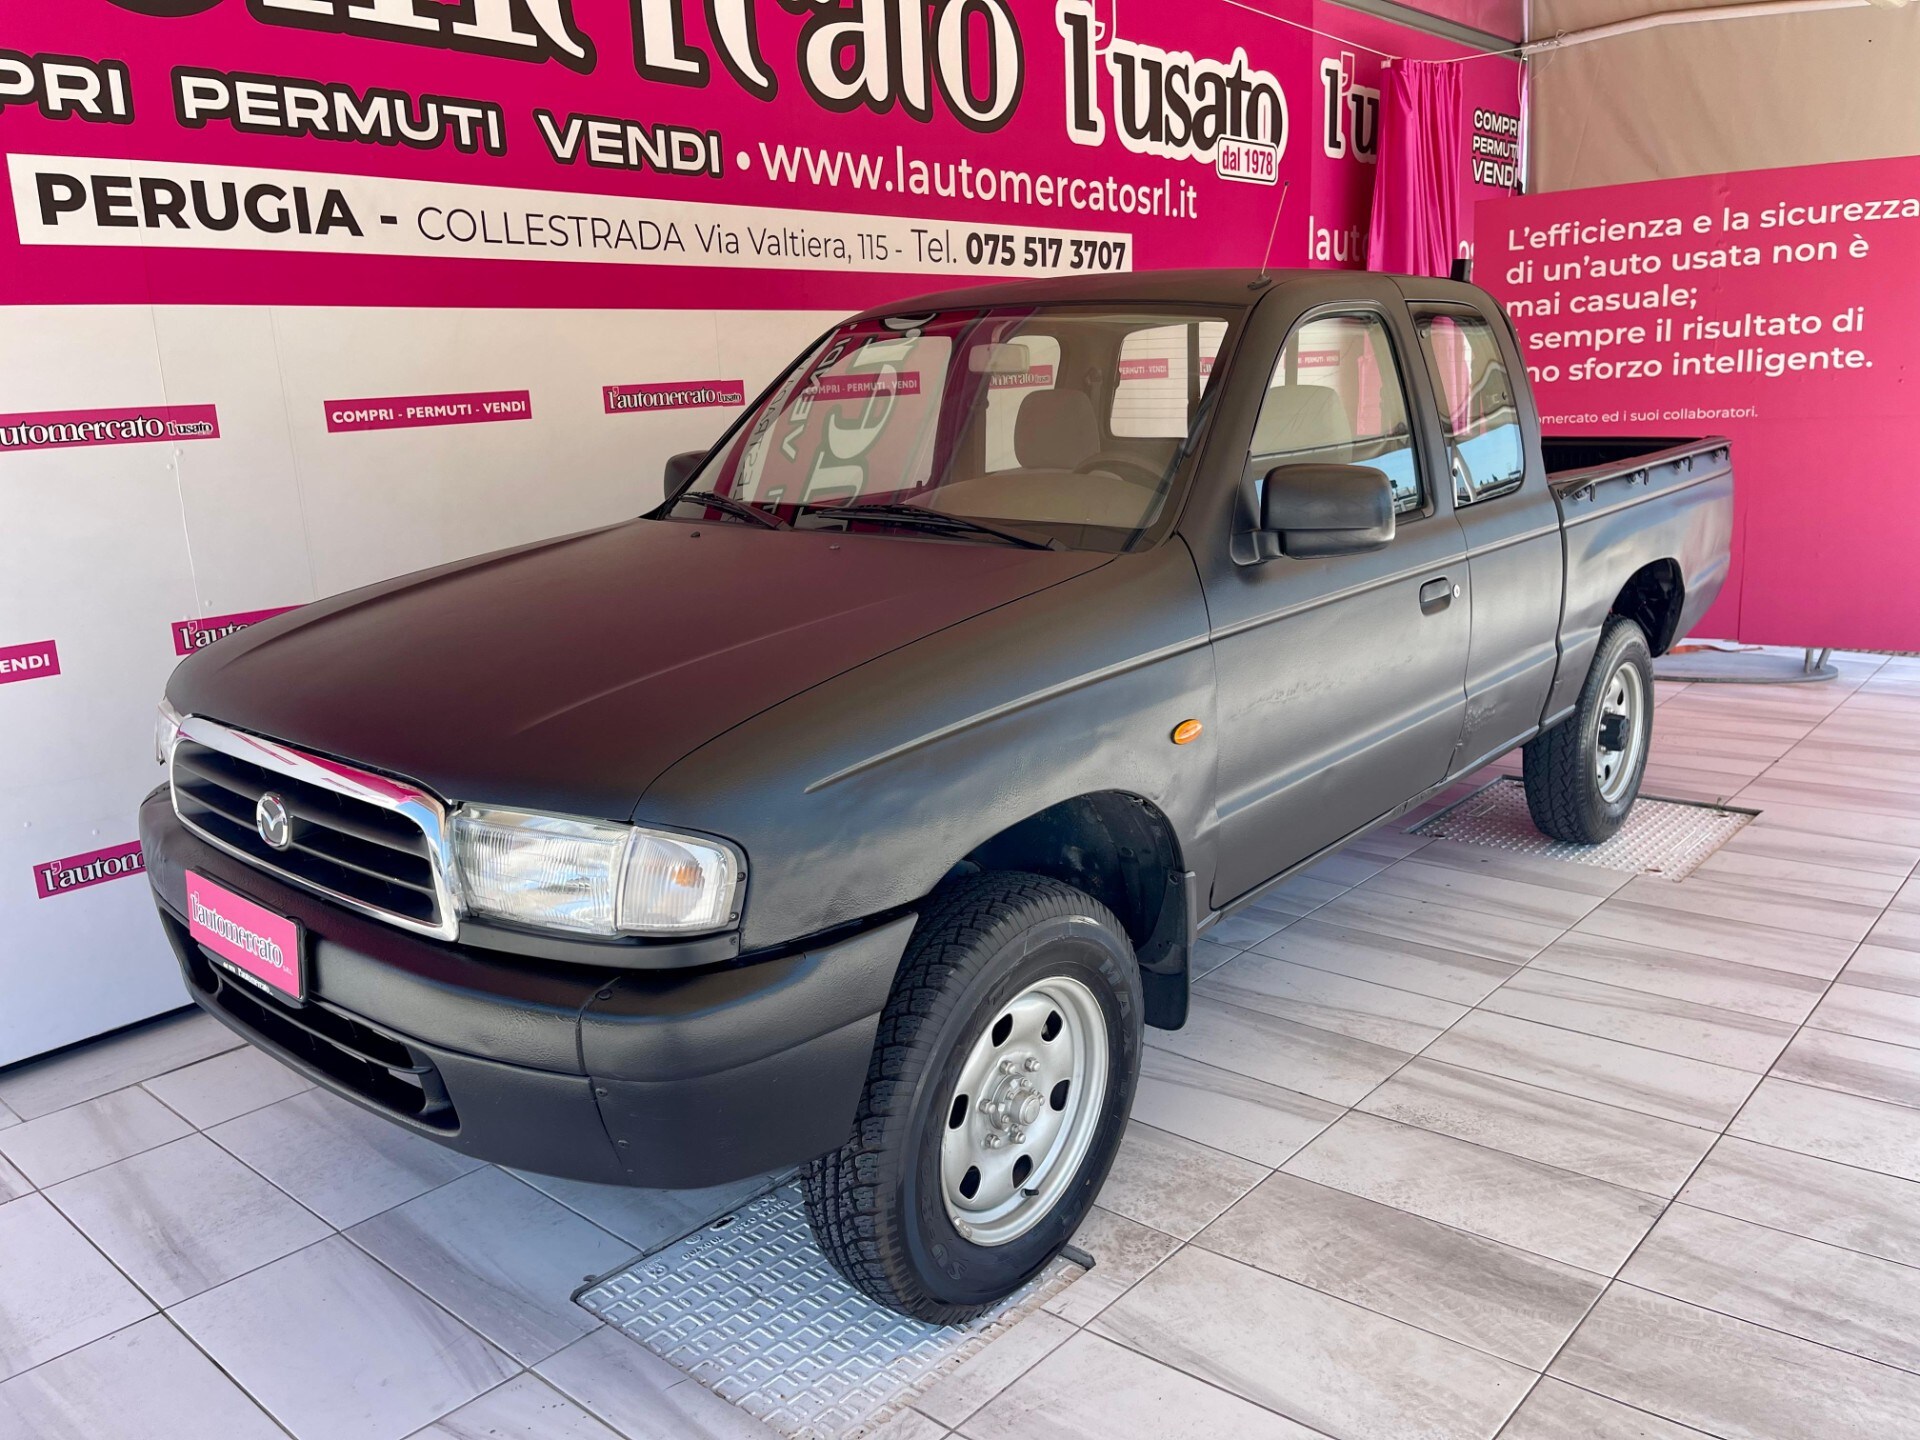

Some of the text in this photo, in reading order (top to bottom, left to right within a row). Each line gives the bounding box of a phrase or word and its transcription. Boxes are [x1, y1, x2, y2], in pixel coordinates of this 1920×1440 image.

[179, 74, 502, 151] PERMUTI
[537, 114, 721, 174] VENDI
[757, 141, 1199, 221] www.lautomercatosrl.it
[1221, 144, 1274, 177] dal 1978
[34, 172, 364, 238] PERUGIA
[416, 206, 687, 253] COLLESTRADA
[694, 223, 741, 255] Via
[747, 226, 852, 265] Valtiera,
[857, 233, 889, 262] 115
[911, 228, 958, 266] Tel.
[966, 231, 1015, 267] 075
[1022, 235, 1063, 269] 517
[1070, 239, 1126, 271] 3707
[1507, 198, 1920, 251] L'efficienza e la sicurezza
[1505, 260, 1534, 285] di
[1542, 254, 1662, 282] un'auto
[1671, 243, 1761, 271] usata
[1772, 239, 1838, 264] non
[1847, 232, 1870, 259] è
[1505, 283, 1698, 319] mai casuale;
[1528, 323, 1646, 352] sempre
[1655, 317, 1673, 343] il
[1682, 312, 1822, 341] risultato
[1831, 306, 1865, 333] di
[1567, 357, 1663, 382] sforzo
[1671, 346, 1874, 378] intelligente.
[331, 408, 395, 424] COMPRI
[406, 403, 473, 419] PERMUTI
[483, 400, 526, 414] VENDI
[1601, 410, 1619, 423] ed
[1630, 409, 1660, 422] suoi
[1662, 405, 1759, 421] collaboratori.
